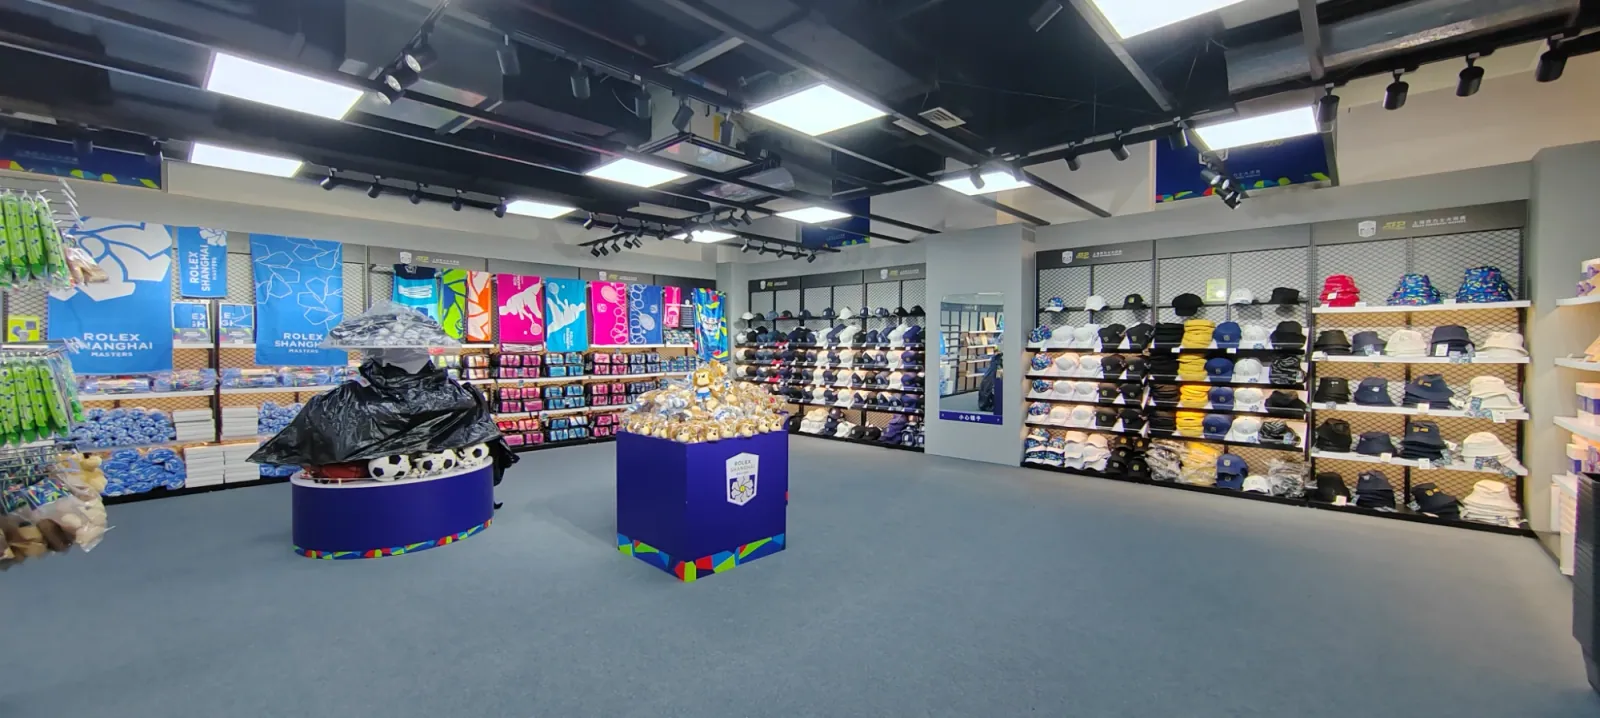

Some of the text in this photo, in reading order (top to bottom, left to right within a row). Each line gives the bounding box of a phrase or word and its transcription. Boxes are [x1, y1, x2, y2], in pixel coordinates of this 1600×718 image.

[188, 251, 200, 283] ROLEX
[200, 245, 210, 292] SHANGHAI
[83, 332, 141, 341] ROLEX
[283, 332, 324, 341] ROLEX
[83, 341, 153, 351] ANGHAI
[274, 340, 322, 348] SHANGH
